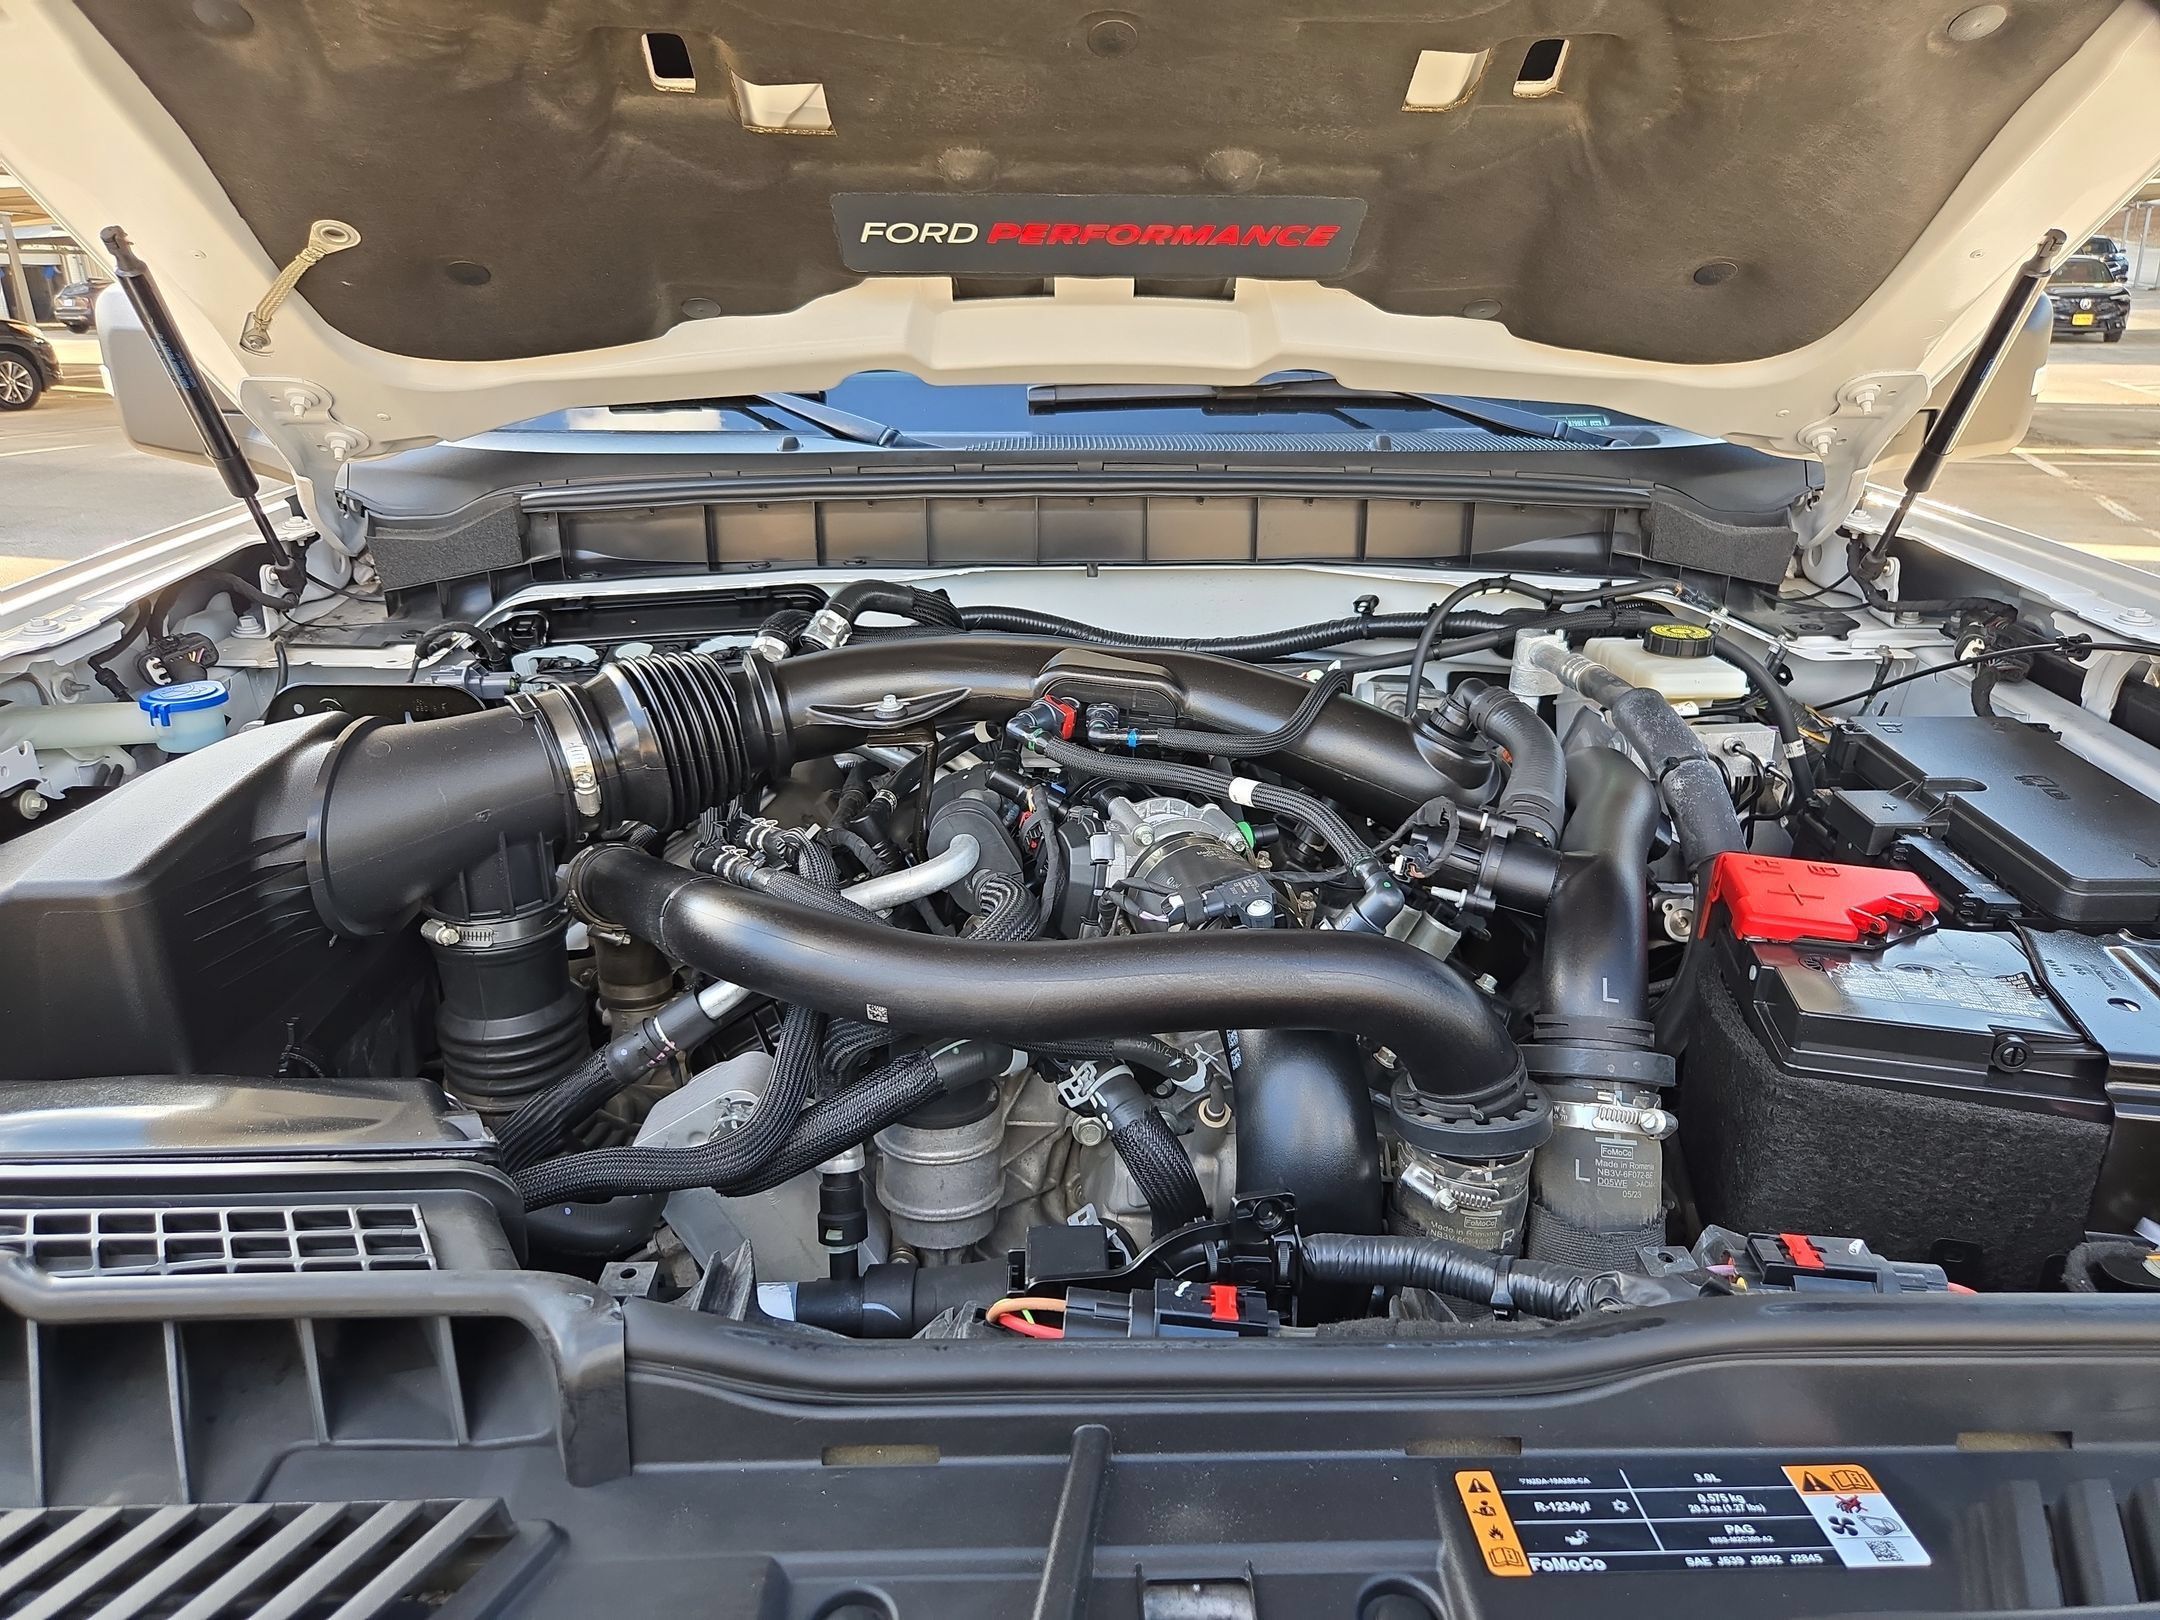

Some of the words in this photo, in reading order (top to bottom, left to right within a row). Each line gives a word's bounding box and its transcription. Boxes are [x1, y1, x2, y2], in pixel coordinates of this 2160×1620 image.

[860, 222, 979, 244] FORD
[987, 222, 1341, 247] PERFORMANCE
[1602, 977, 1620, 1004] L
[1602, 1147, 1632, 1157] FoMoCo
[1595, 1158, 1618, 1168] Made
[1620, 1161, 1628, 1169] in
[1575, 1158, 1591, 1183] L
[1622, 1190, 1642, 1199] 05/23
[1430, 1220, 1454, 1233] Made
[1465, 1218, 1495, 1227] FoMoCo
[1501, 1228, 1515, 1250] R
[1693, 1473, 1722, 1483] 3.0L
[1696, 1493, 1729, 1504] 0.575
[1728, 1493, 1746, 1505] kg
[1533, 1500, 1592, 1515] R-1234yf
[1688, 1504, 1711, 1514] 20.3
[1710, 1505, 1723, 1513] oz
[1722, 1503, 1746, 1514] (1.27
[1745, 1503, 1767, 1514] lbs)
[1724, 1524, 1756, 1535] PAG
[1528, 1556, 1608, 1572] FoMoCo
[1684, 1556, 1713, 1568] SAE
[1717, 1555, 1746, 1567] J639
[1750, 1554, 1784, 1566] J2842
[1789, 1553, 1824, 1566] J2845
